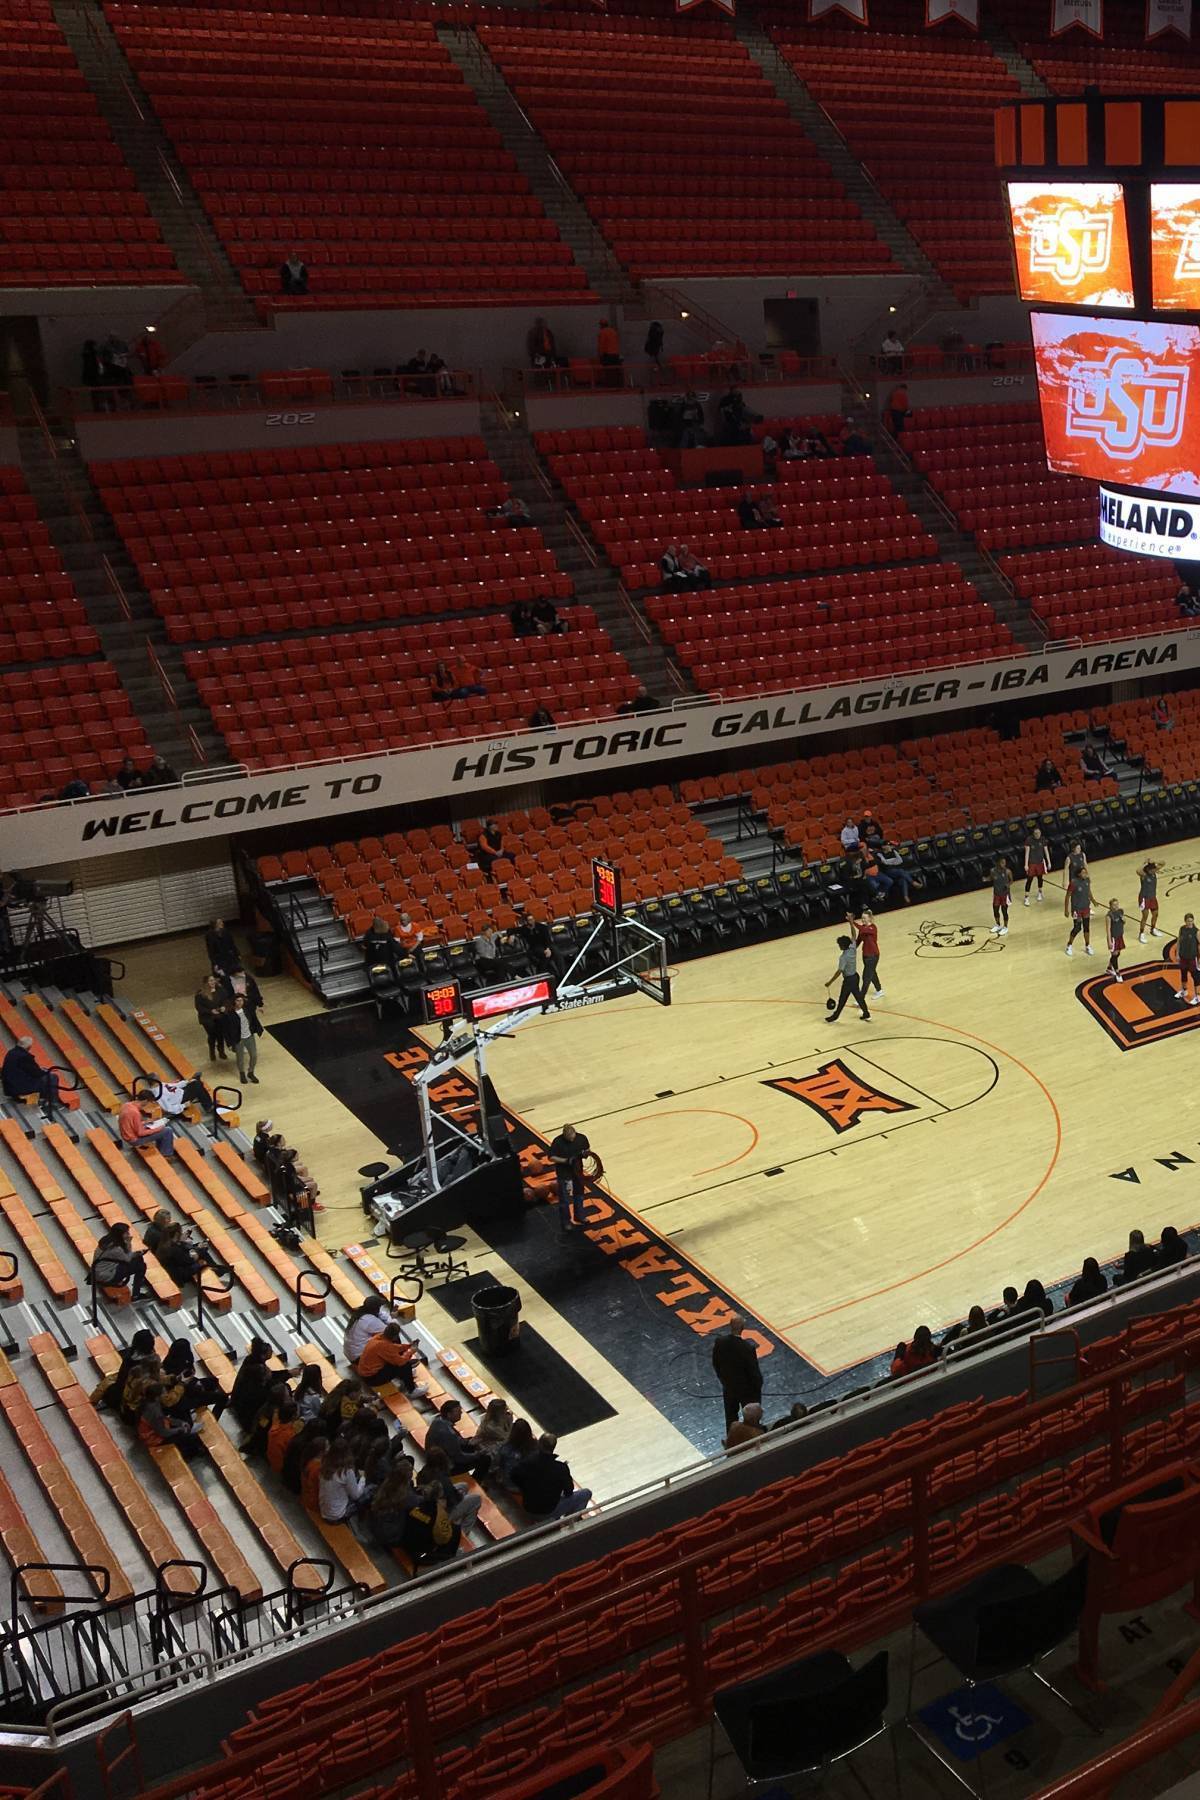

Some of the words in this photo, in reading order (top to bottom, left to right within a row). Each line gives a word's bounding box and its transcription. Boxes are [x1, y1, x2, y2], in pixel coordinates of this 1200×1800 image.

[1029, 208, 1113, 286] OSU
[1066, 348, 1190, 460] OSU
[265, 412, 316, 426] 202
[81, 784, 309, 841] WELCOME
[324, 773, 381, 799] TO
[451, 722, 687, 782] HISTORIC
[1064, 643, 1178, 679] ARENA
[596, 866, 615, 885] 43:03
[427, 986, 455, 1000] 43:03
[434, 1000, 452, 1016] 30
[1118, 1616, 1153, 1645] AT
